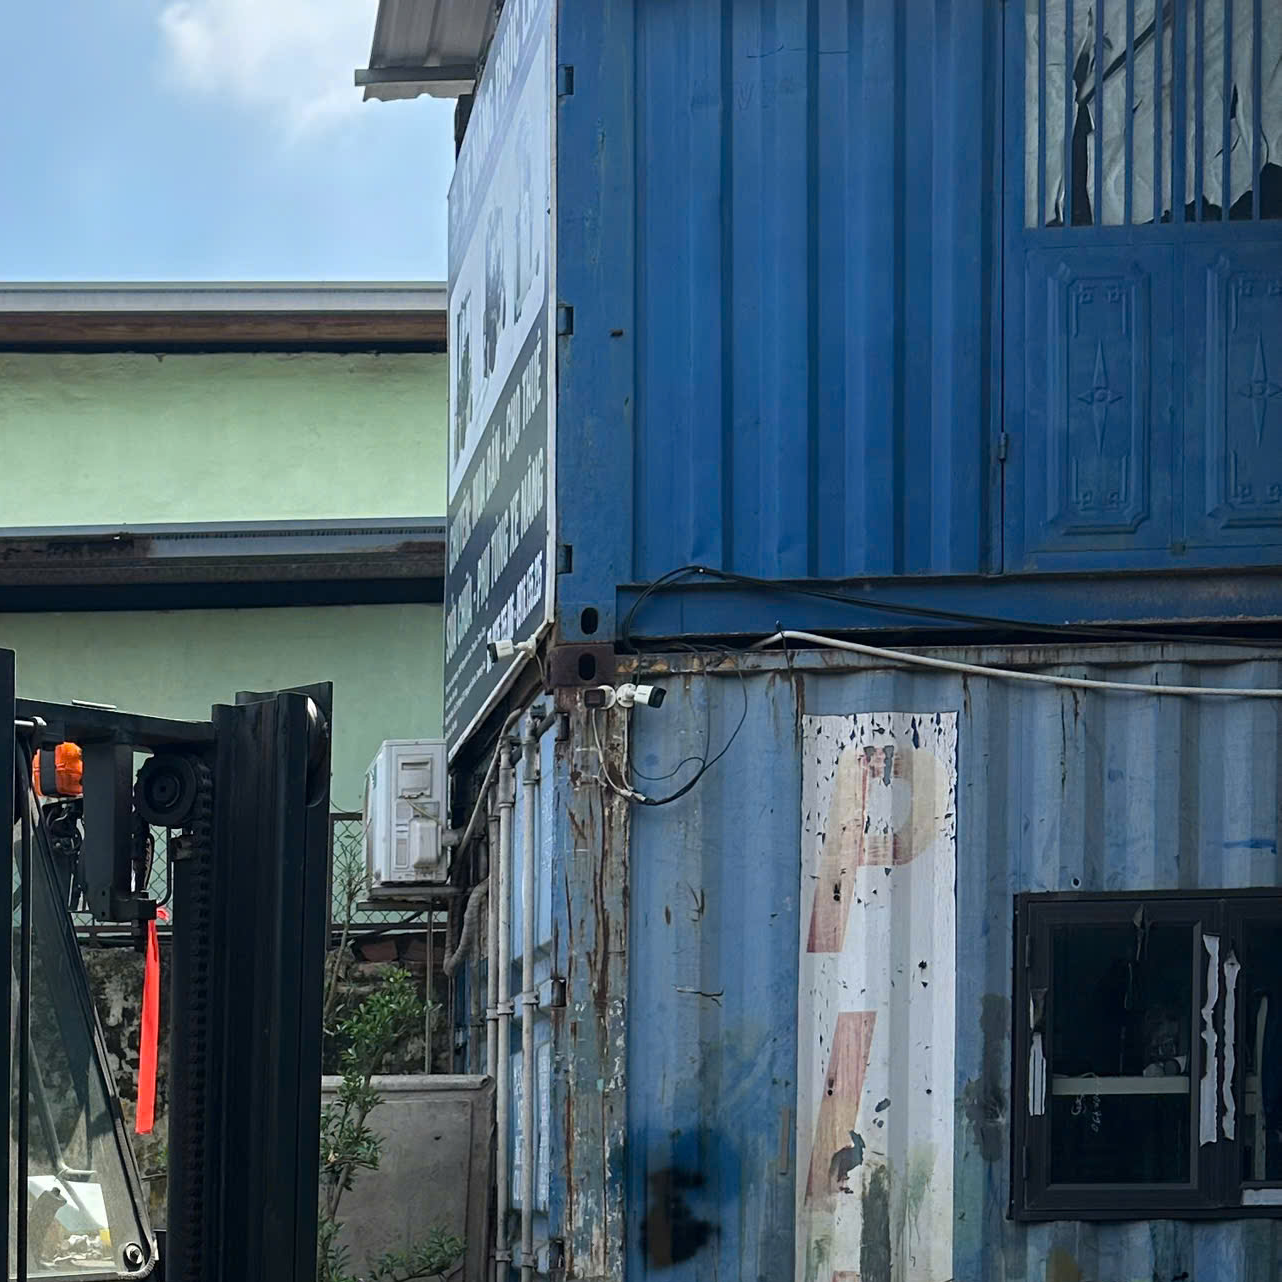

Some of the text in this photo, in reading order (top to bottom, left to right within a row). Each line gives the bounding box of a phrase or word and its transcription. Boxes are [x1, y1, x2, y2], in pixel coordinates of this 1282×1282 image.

[505, 384, 521, 462] CHO
[522, 328, 542, 430] THUÊ
[509, 487, 520, 558] XE
[521, 447, 544, 538] NÂNG
